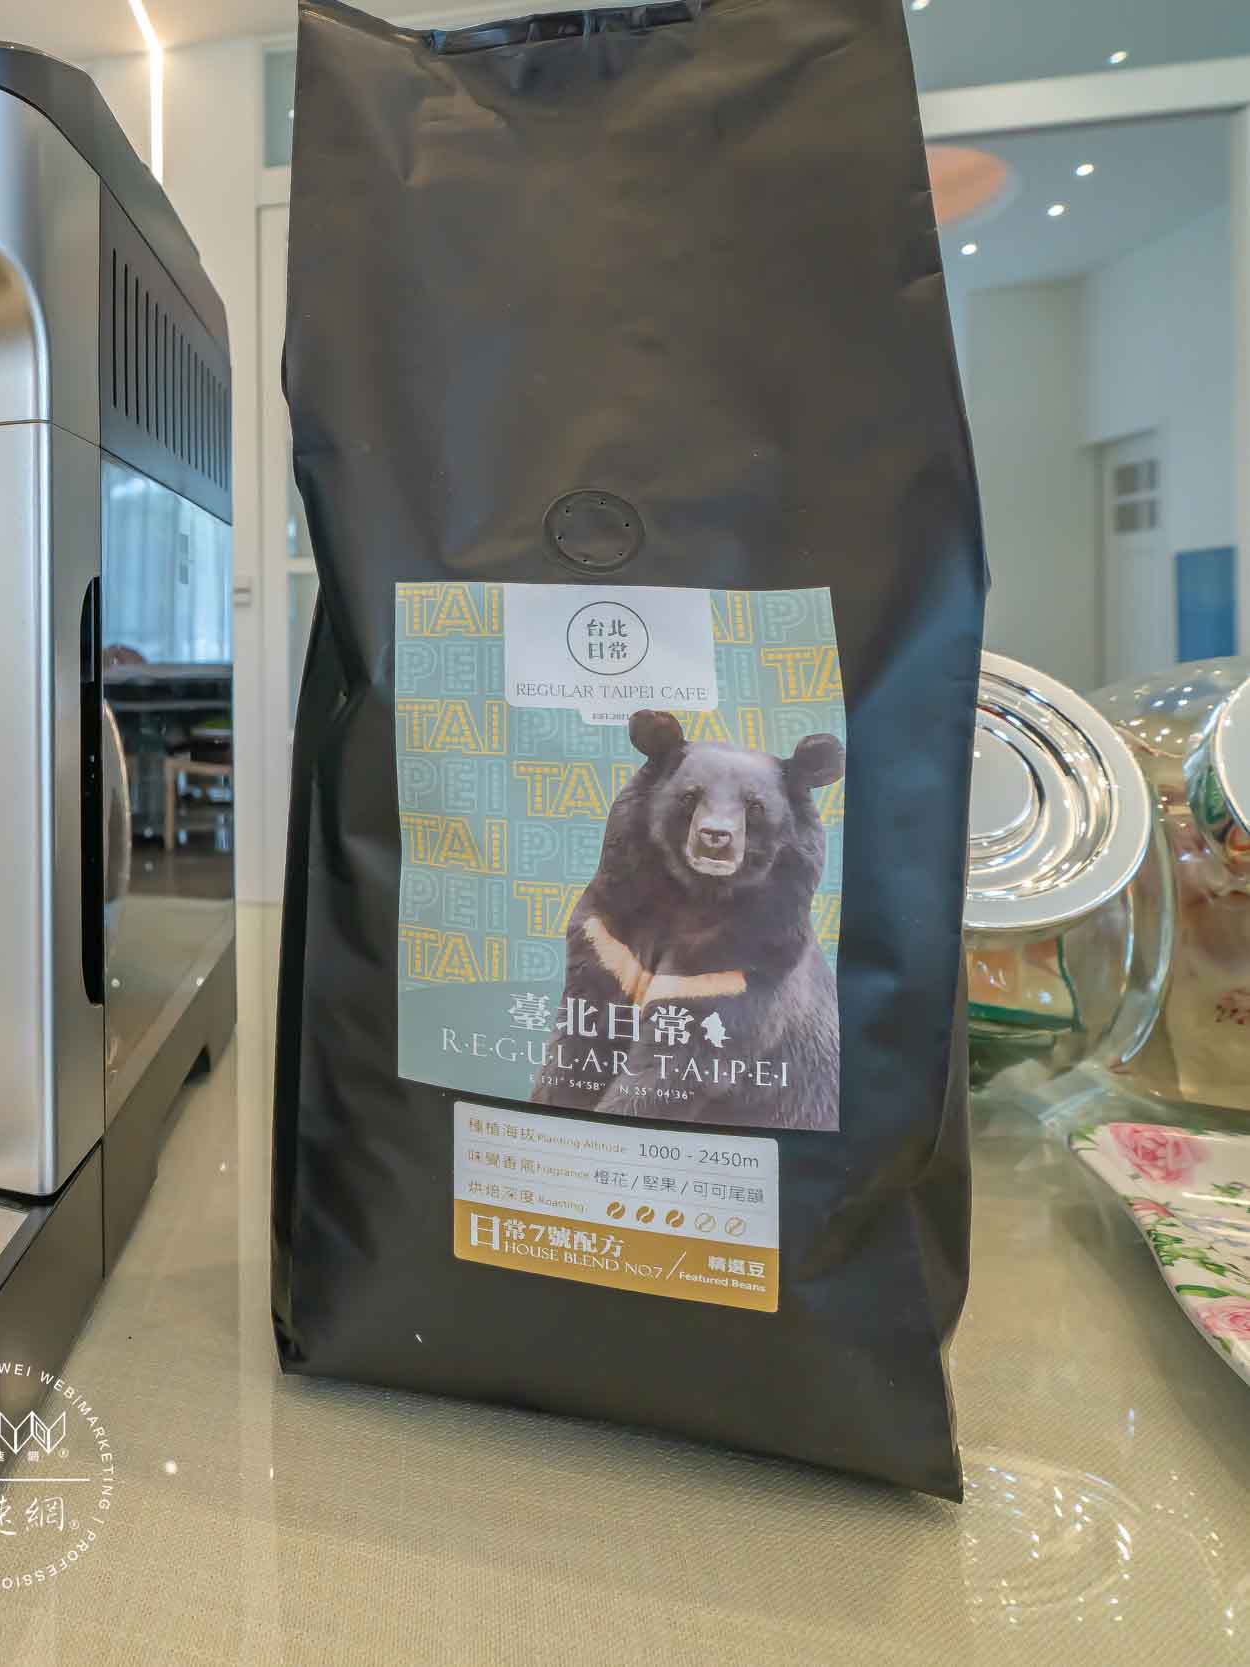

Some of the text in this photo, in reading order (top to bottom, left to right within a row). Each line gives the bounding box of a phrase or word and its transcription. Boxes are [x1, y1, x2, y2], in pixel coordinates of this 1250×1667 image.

[397, 583, 503, 638] TAI
[586, 618, 629, 638] 台北
[587, 641, 628, 660] 日常
[516, 682, 708, 701] REGULAR TAIPEI CAFE
[397, 697, 508, 755] TAI
[400, 812, 508, 876] TAI
[398, 924, 508, 984] TAI
[507, 991, 695, 1047] 臺北日常
[639, 1143, 681, 1161] 1000
[699, 1149, 759, 1169] 2450m
[504, 1241, 559, 1262] HOUSE
[564, 1252, 619, 1272] BLEND
[678, 1271, 767, 1293] Featured Beans
